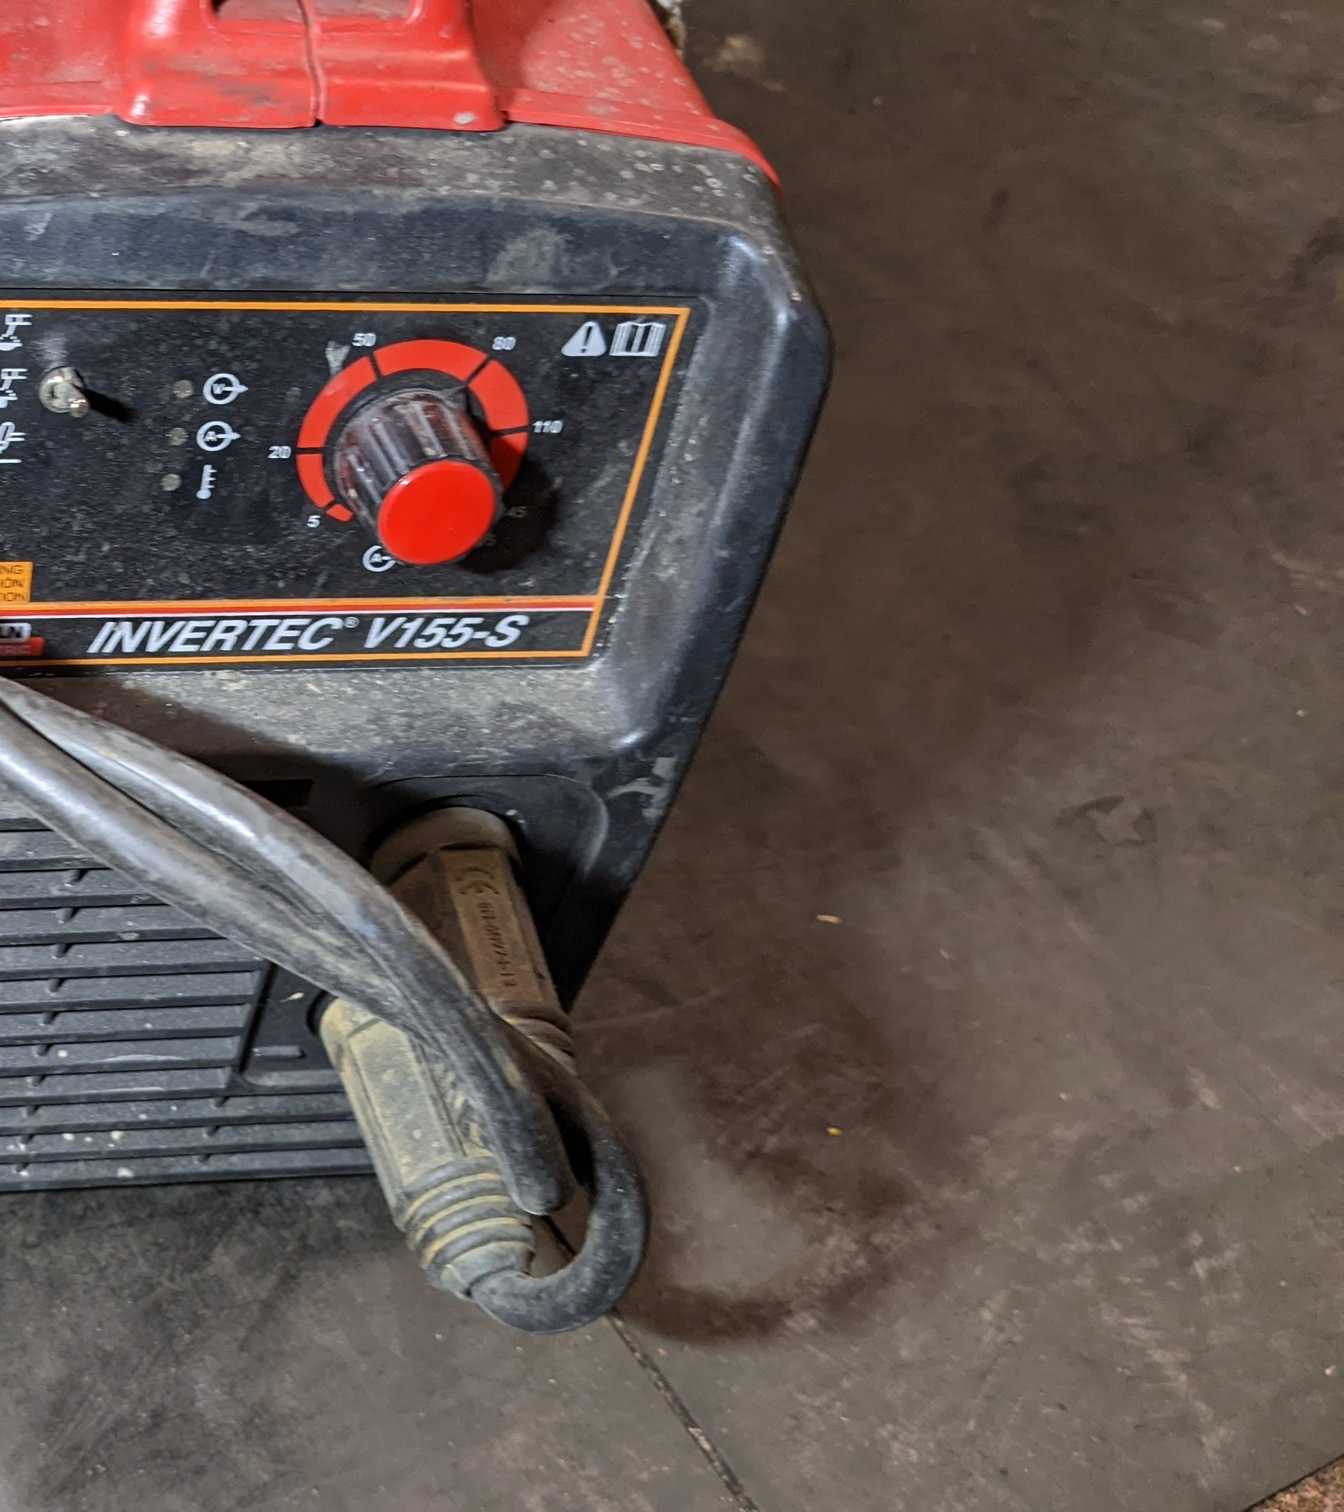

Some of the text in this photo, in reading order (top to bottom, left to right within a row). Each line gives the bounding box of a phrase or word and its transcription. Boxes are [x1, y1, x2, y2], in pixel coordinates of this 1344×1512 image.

[352, 333, 377, 347] 50
[492, 337, 517, 350] 80
[532, 420, 563, 433] 110
[268, 446, 292, 459] 20
[306, 515, 321, 528] 5
[363, 615, 530, 649] V155-S
